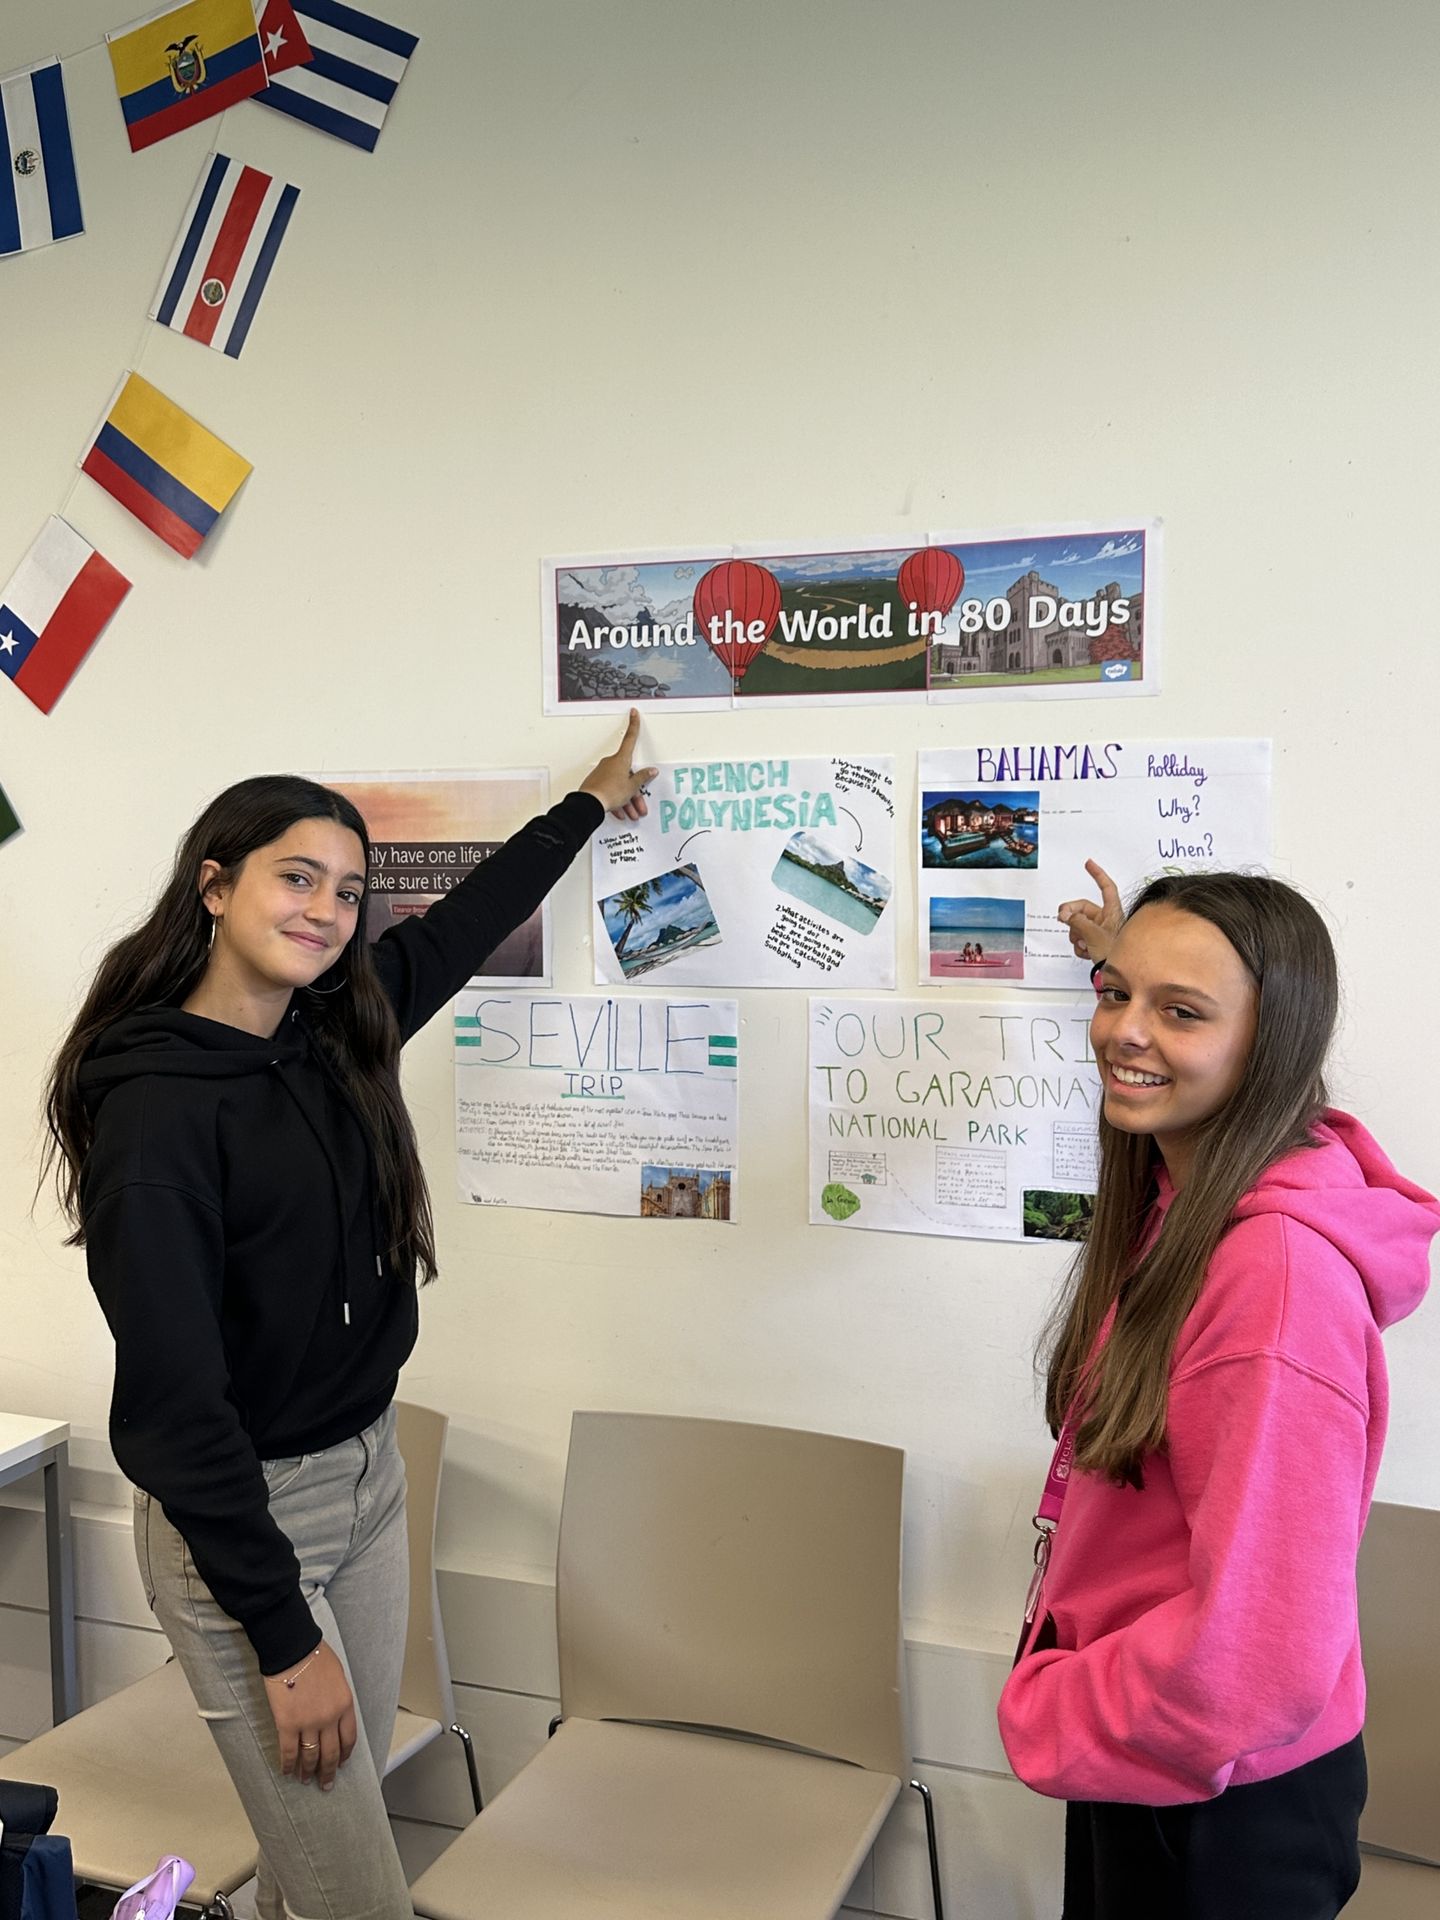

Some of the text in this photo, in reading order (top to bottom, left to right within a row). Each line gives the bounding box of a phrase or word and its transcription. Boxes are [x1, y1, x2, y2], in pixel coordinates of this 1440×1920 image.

[568, 596, 1131, 650] Around the World in 80 Days
[674, 760, 790, 795] FRENCH
[884, 776, 893, 785] to
[977, 744, 1208, 787] BAHAMAS holliday
[1158, 795, 1201, 823] Why?
[369, 846, 387, 867] nly
[391, 846, 424, 863] have
[428, 850, 456, 863] one
[460, 846, 481, 863] life
[1158, 833, 1213, 858] When?
[369, 873, 395, 889] ake
[399, 876, 429, 889] sure
[433, 873, 452, 889] it's
[789, 930, 801, 939] are
[804, 936, 821, 948] going
[836, 1012, 1096, 1063] OUR TRI
[815, 1066, 867, 1104] TO
[828, 1112, 1028, 1145] NATIONAL PARK
